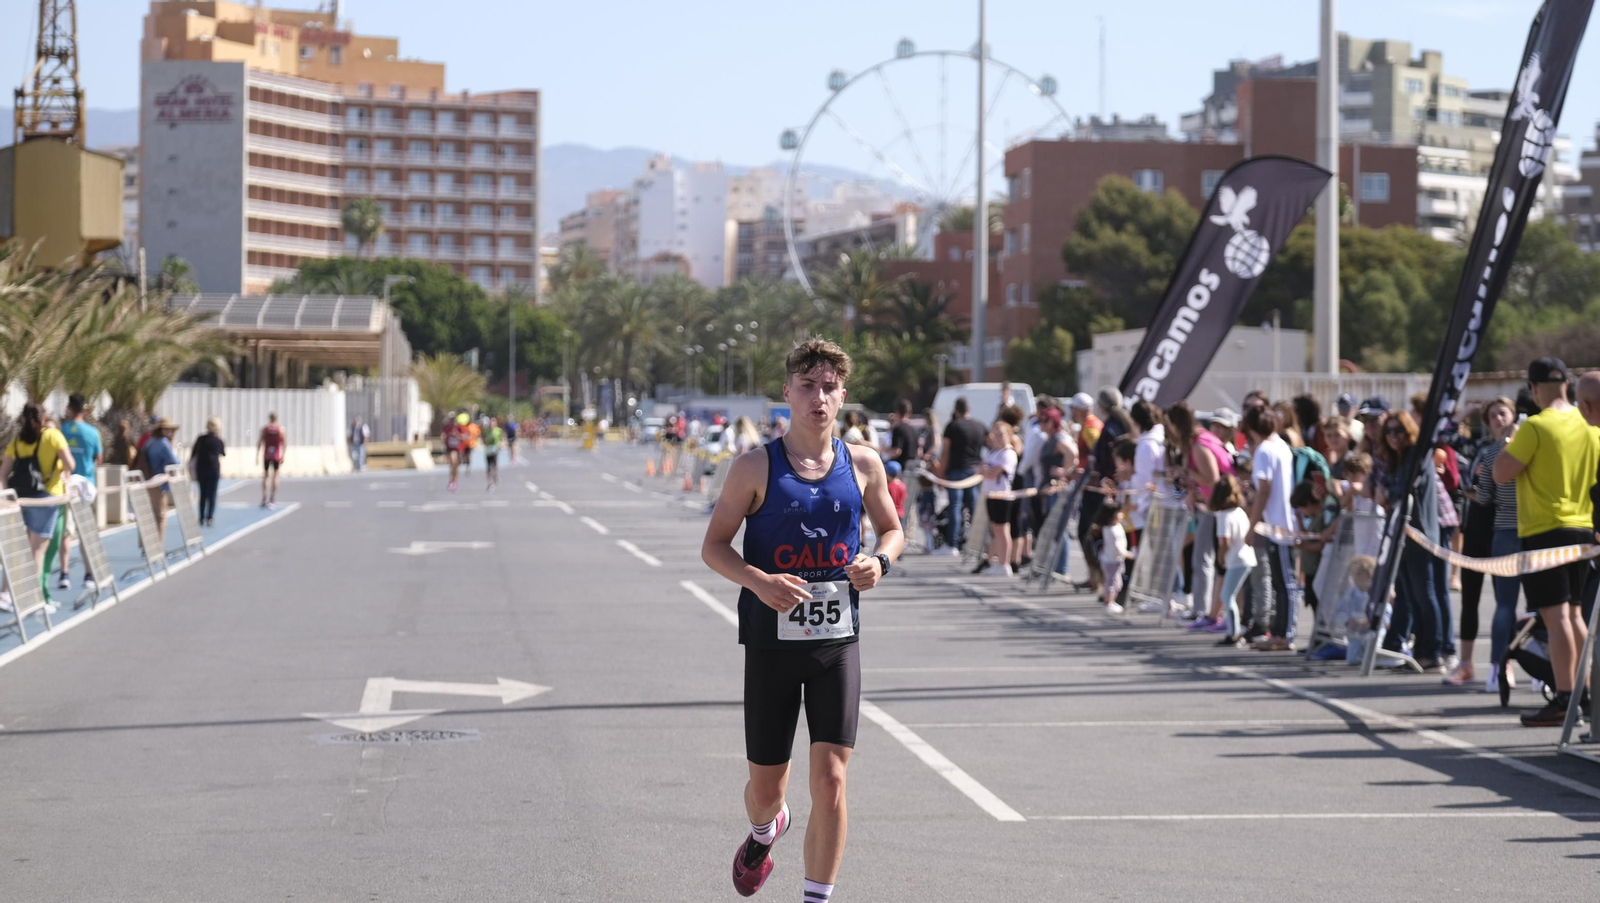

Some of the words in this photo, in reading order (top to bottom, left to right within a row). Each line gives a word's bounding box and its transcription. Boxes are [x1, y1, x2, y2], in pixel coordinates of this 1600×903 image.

[774, 542, 848, 569] GALO
[798, 570, 827, 578] SPORT
[788, 600, 841, 626] 455
